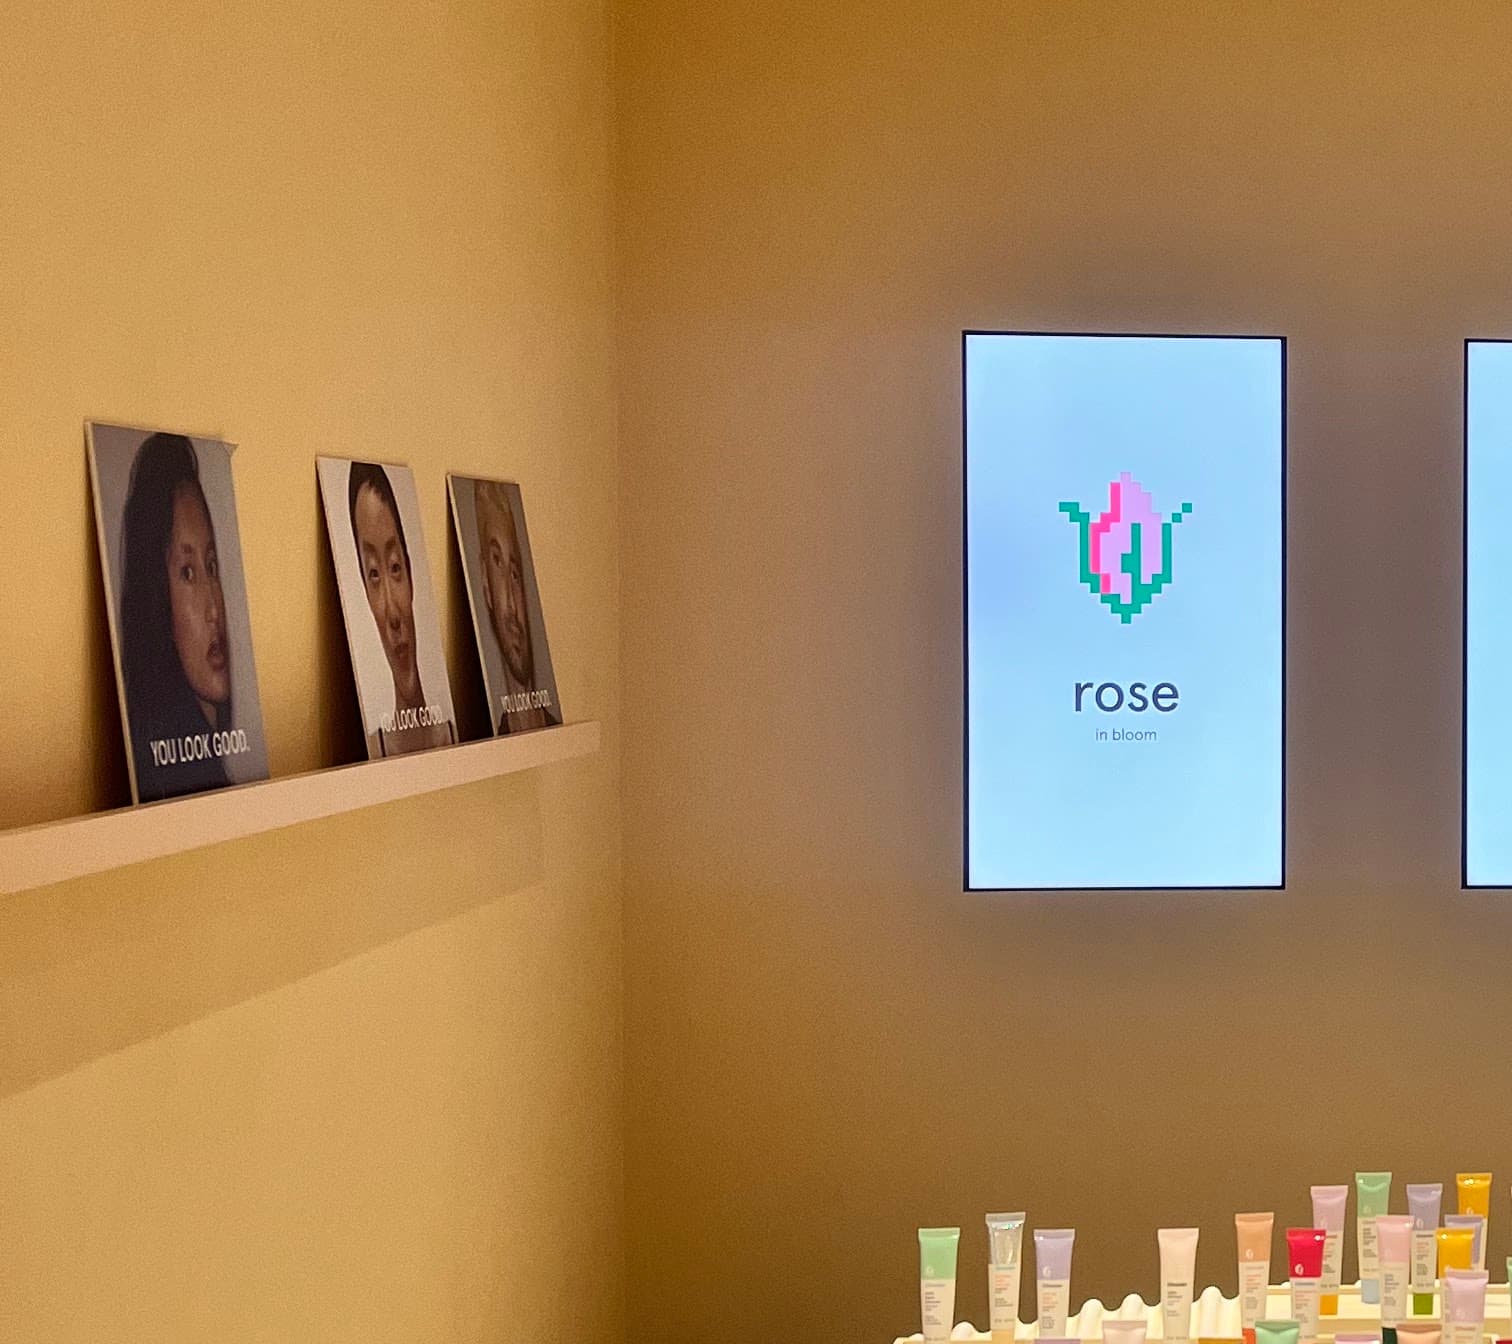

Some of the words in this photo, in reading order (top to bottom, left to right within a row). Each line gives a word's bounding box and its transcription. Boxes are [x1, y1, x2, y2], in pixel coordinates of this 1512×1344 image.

[514, 692, 533, 712] LOOK
[1074, 682, 1179, 712] rose
[396, 707, 420, 730] LOOK
[1095, 728, 1108, 741] in
[1112, 728, 1157, 741] bloom
[149, 738, 177, 766] YOU
[177, 734, 212, 762] LOOK
[213, 729, 251, 756] GOOD.
